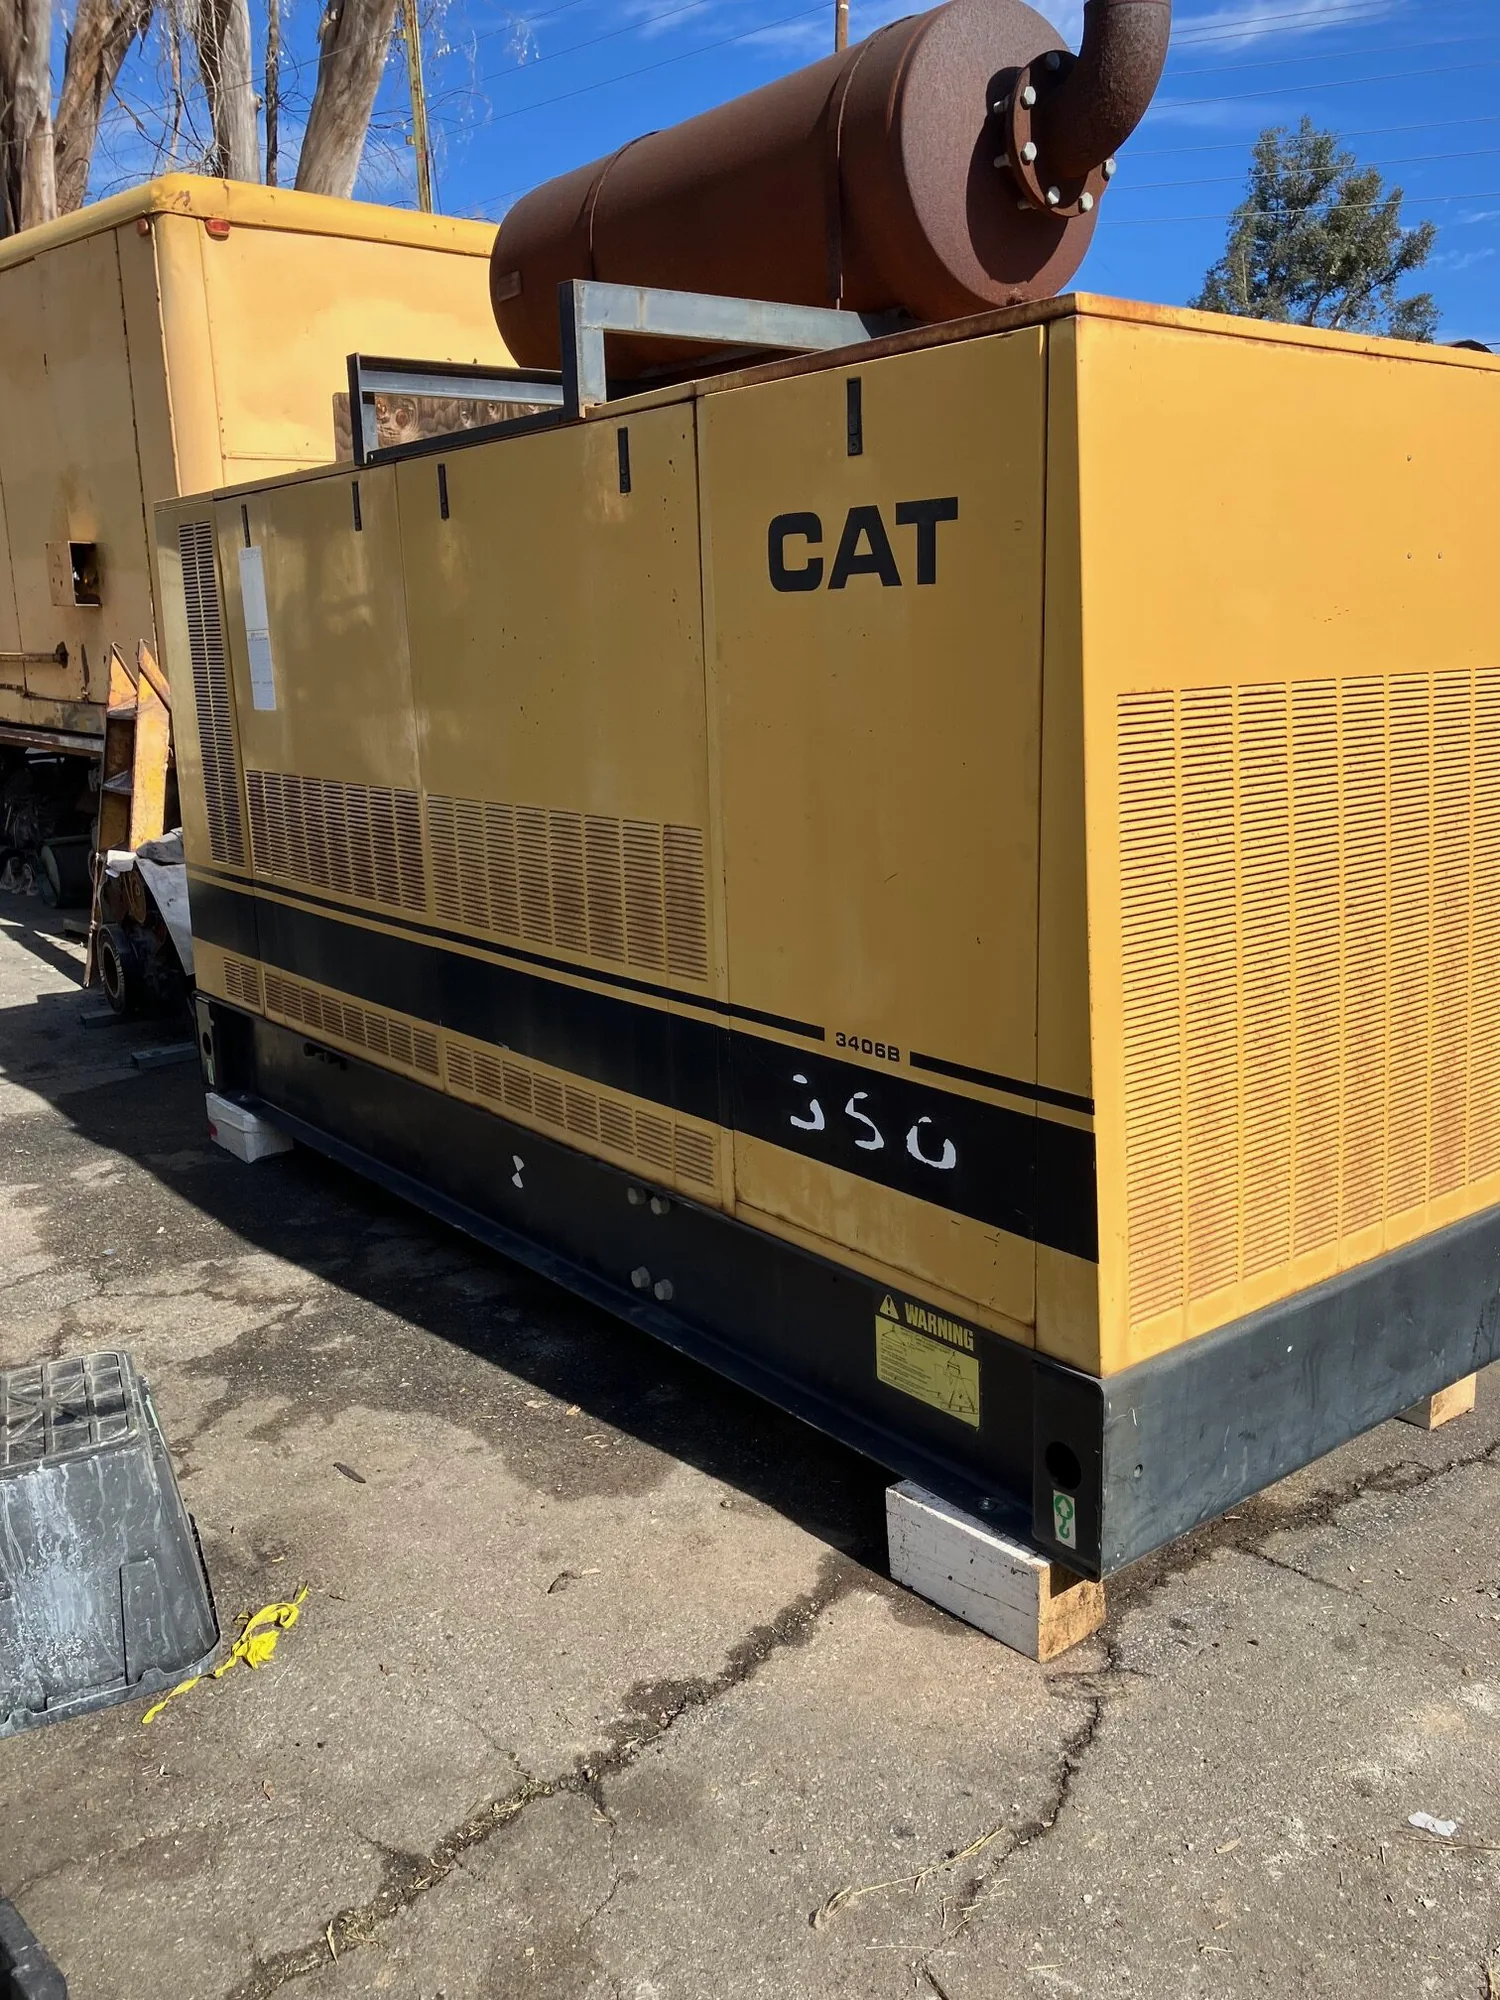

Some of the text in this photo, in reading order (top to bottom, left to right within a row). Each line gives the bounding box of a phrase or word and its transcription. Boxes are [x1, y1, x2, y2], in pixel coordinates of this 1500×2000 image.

[768, 496, 958, 592] CAT
[835, 1032, 900, 1062] 3406B
[904, 1301, 974, 1352] WARNING
